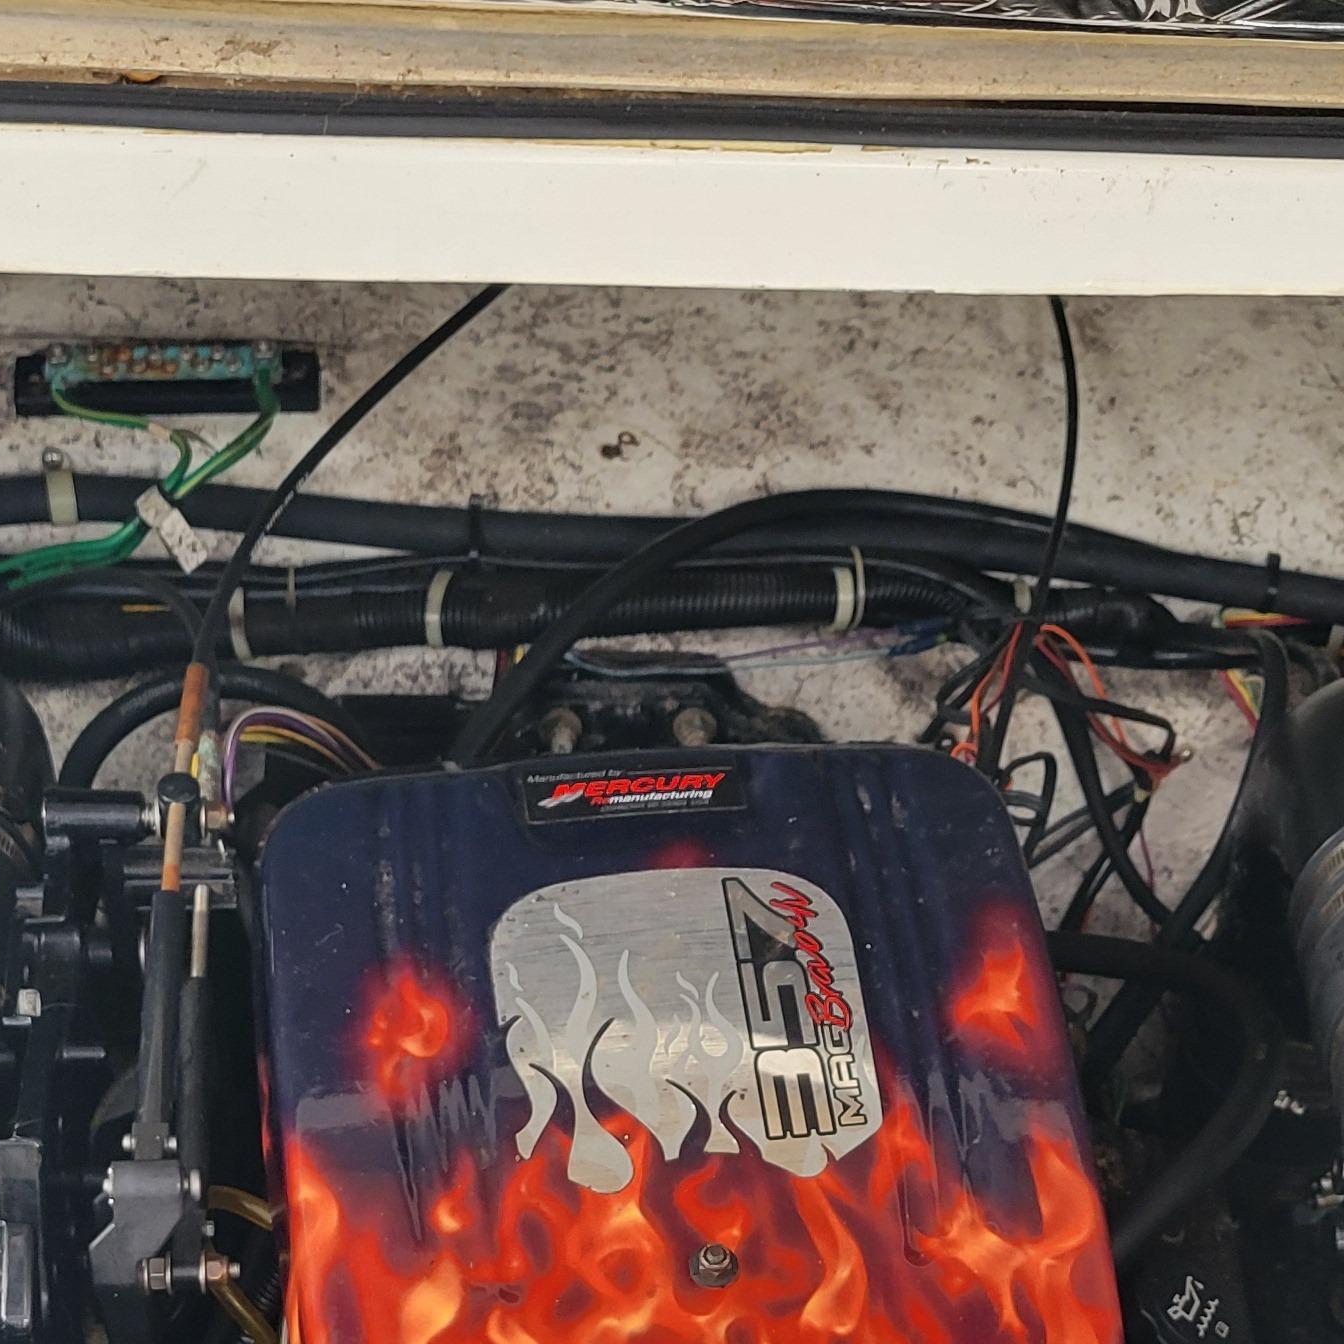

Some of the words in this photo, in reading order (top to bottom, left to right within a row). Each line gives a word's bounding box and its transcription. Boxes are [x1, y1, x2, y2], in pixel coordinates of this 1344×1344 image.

[552, 773, 725, 800] MERCURY
[590, 789, 713, 807] Remanufacturing
[722, 877, 837, 1139] 357
[792, 929, 853, 1032] Bravo
[821, 1022, 867, 1126] MAG
